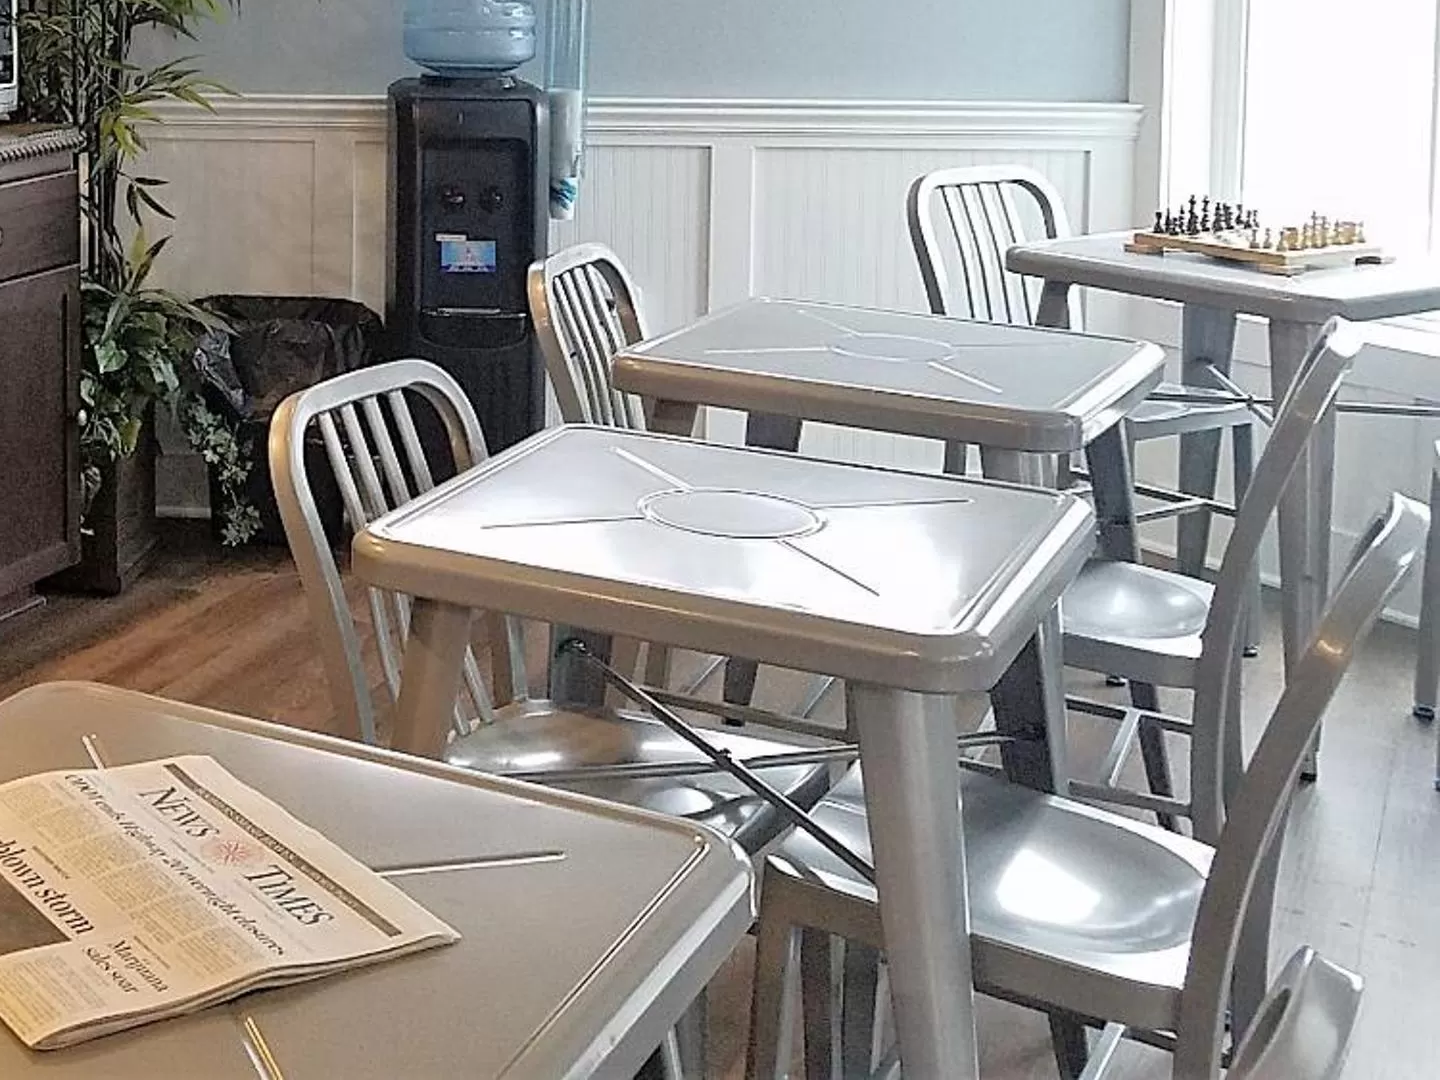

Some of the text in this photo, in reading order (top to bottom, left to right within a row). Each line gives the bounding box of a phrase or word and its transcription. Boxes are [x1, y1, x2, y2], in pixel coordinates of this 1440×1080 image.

[138, 786, 335, 926] NEWS TIMES
[34, 887, 95, 935] storm
[82, 946, 111, 972] sales
[112, 971, 140, 994] soar
[108, 939, 169, 993] Marijuana
